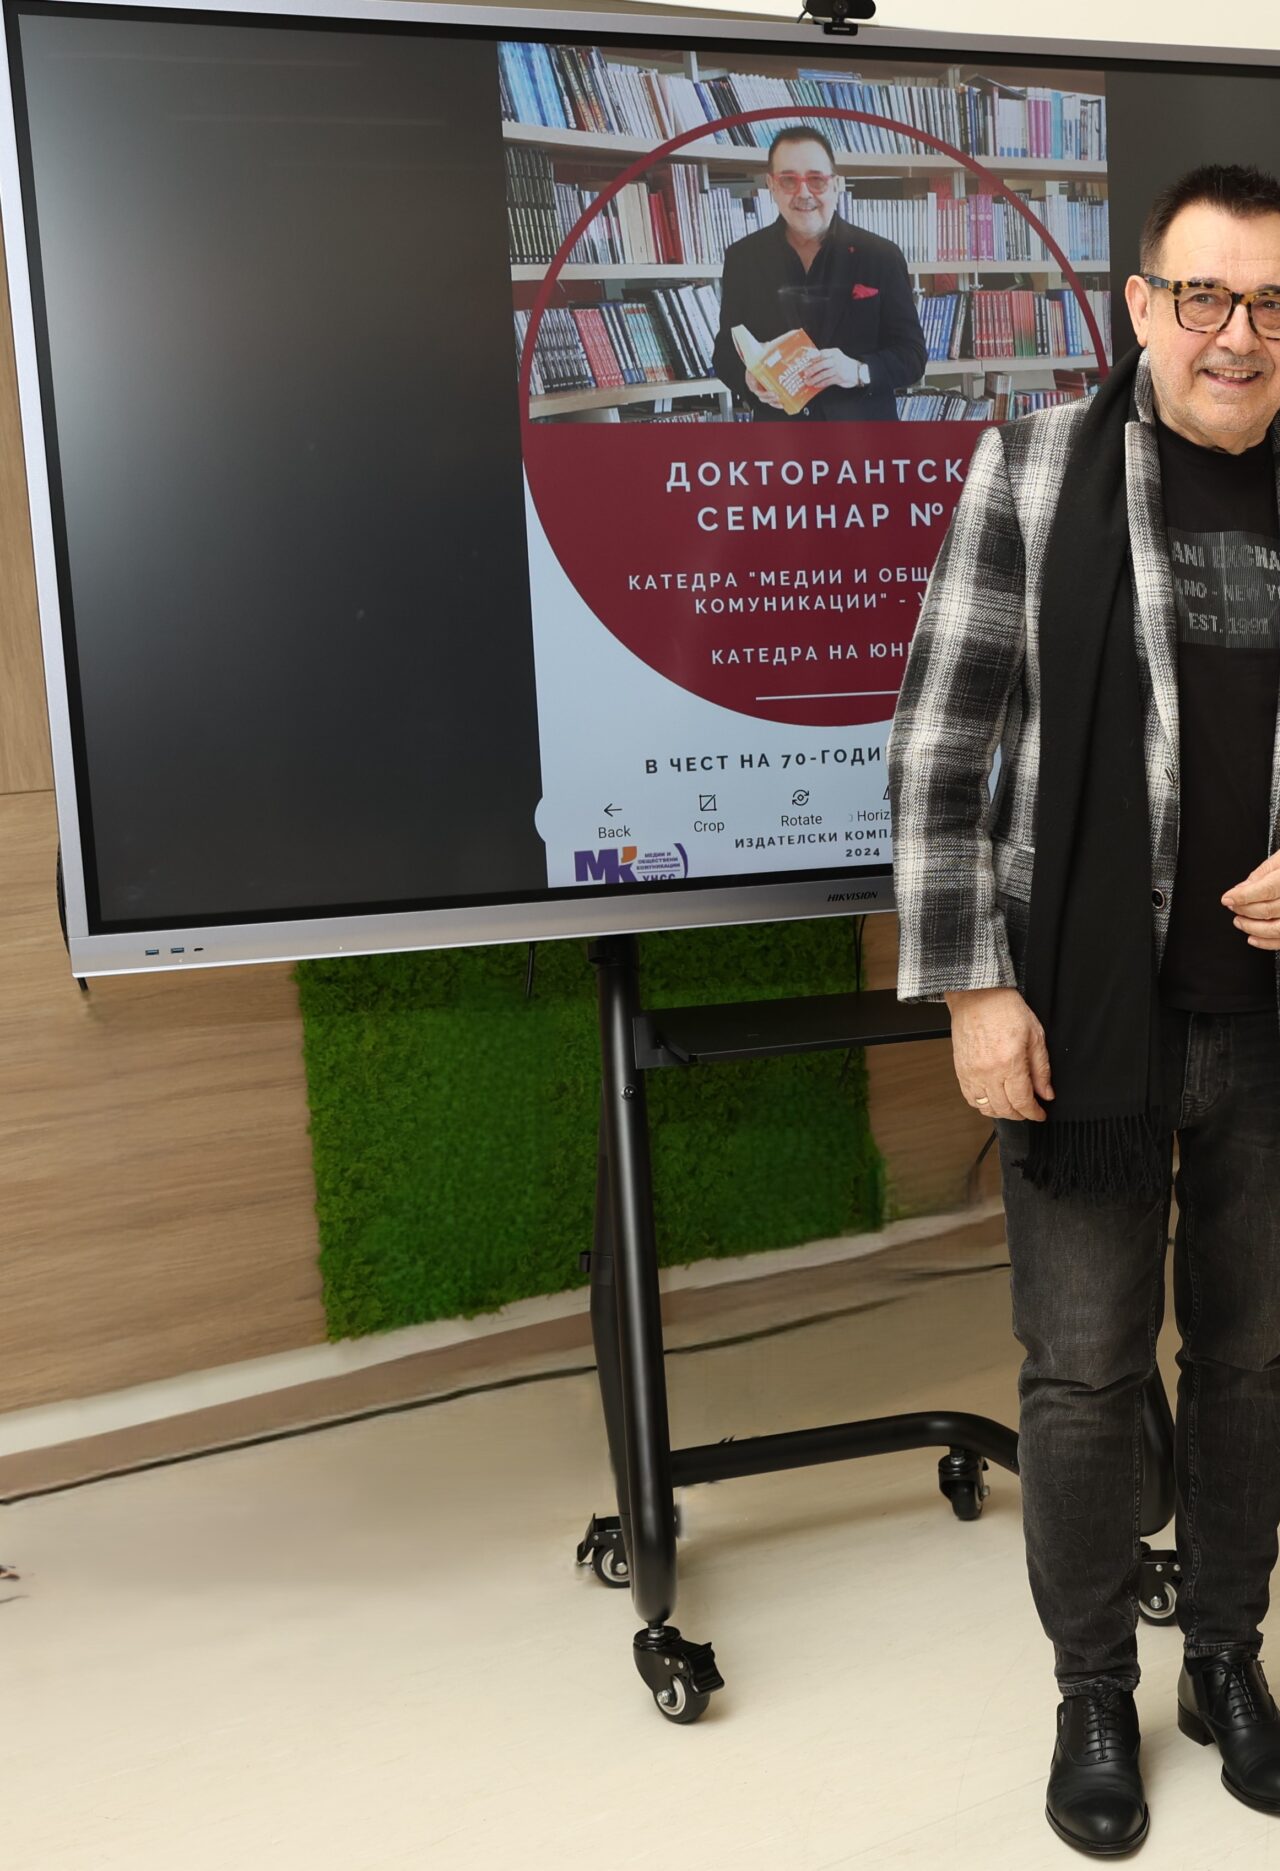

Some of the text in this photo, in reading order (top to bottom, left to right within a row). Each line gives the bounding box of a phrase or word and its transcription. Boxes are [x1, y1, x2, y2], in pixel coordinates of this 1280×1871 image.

[666, 458, 965, 492] ДОКТОРАНТСК
[697, 504, 890, 531] СЕМИНАР
[628, 572, 738, 592] КАТЕДРА
[750, 569, 842, 588] "МЕДИИ
[854, 568, 867, 584] И
[695, 593, 886, 615] КОМУНИКАЦИИ"
[1189, 612, 1223, 633] EST.
[712, 646, 818, 666] КАТЕДРА
[829, 644, 858, 660] НА
[645, 759, 657, 774] В
[670, 755, 729, 773] ЧЕСТ
[740, 753, 770, 769] НА
[694, 820, 725, 834] Crop
[781, 813, 822, 827] Rotate
[598, 826, 631, 839] Back
[735, 832, 838, 850] ИЗДАТЕЛСКИ
[845, 848, 880, 857] 2024
[827, 891, 879, 903] HIKVISION
